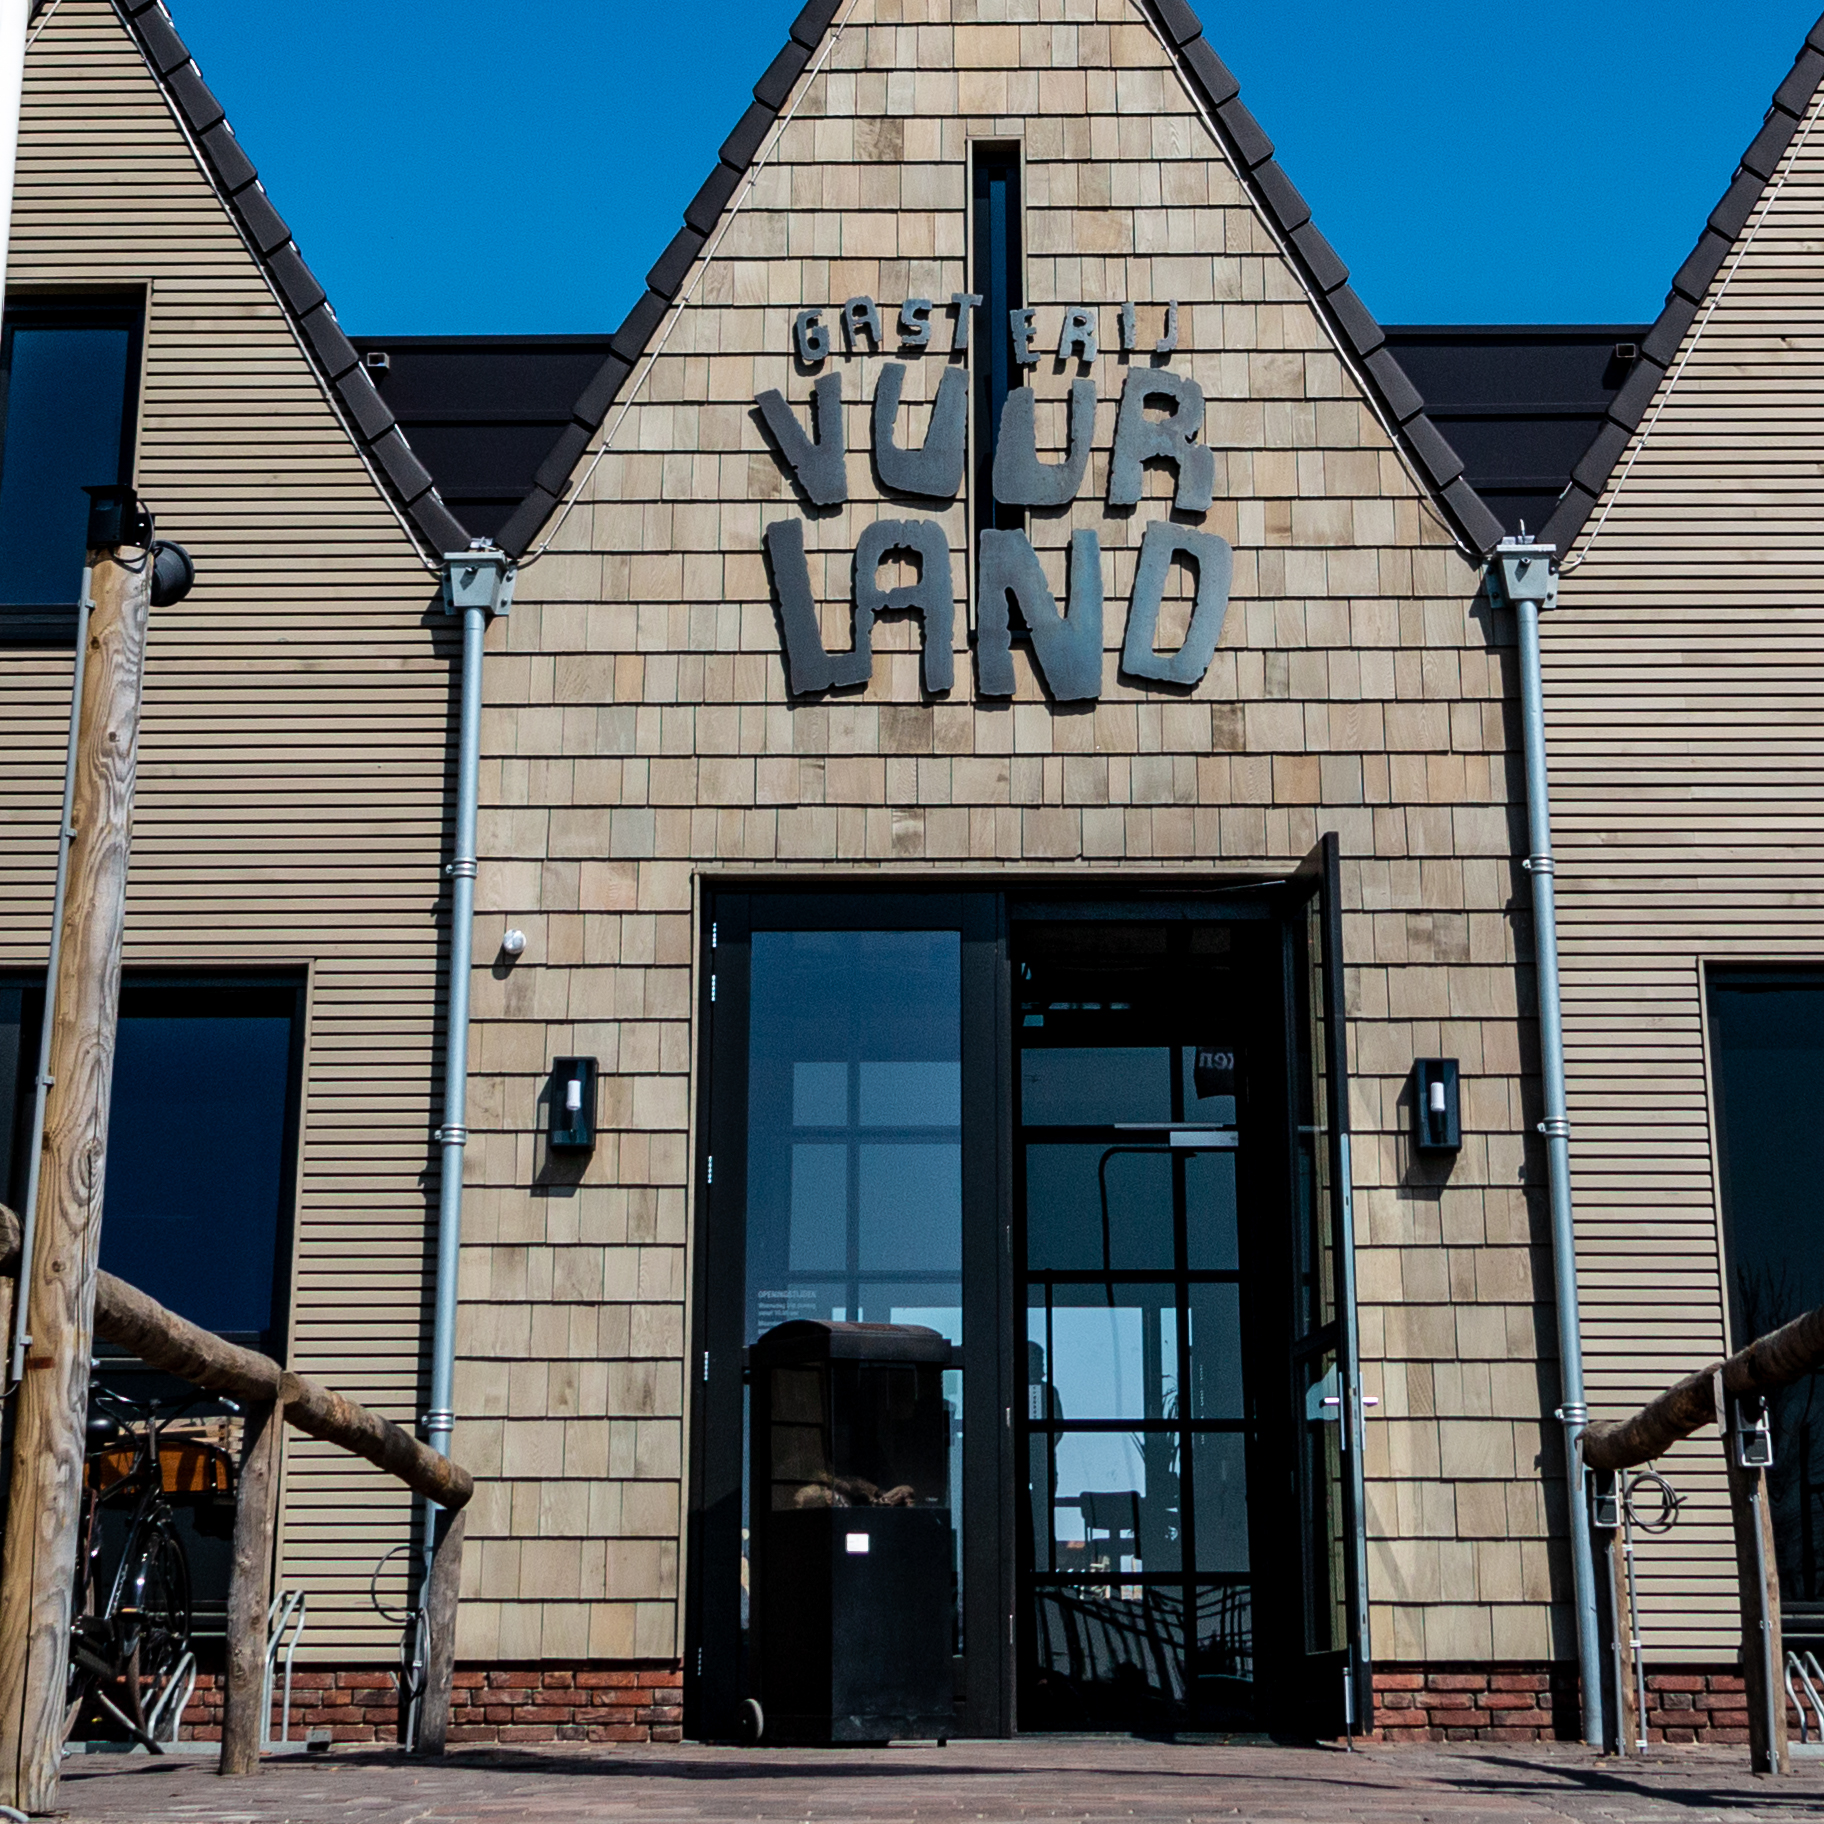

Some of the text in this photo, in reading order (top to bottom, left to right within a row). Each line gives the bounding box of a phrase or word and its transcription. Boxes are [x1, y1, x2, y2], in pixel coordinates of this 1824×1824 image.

[796, 293, 1177, 364] GASTERIJ
[754, 363, 1216, 512] VUUR
[766, 517, 1234, 701] LAND
